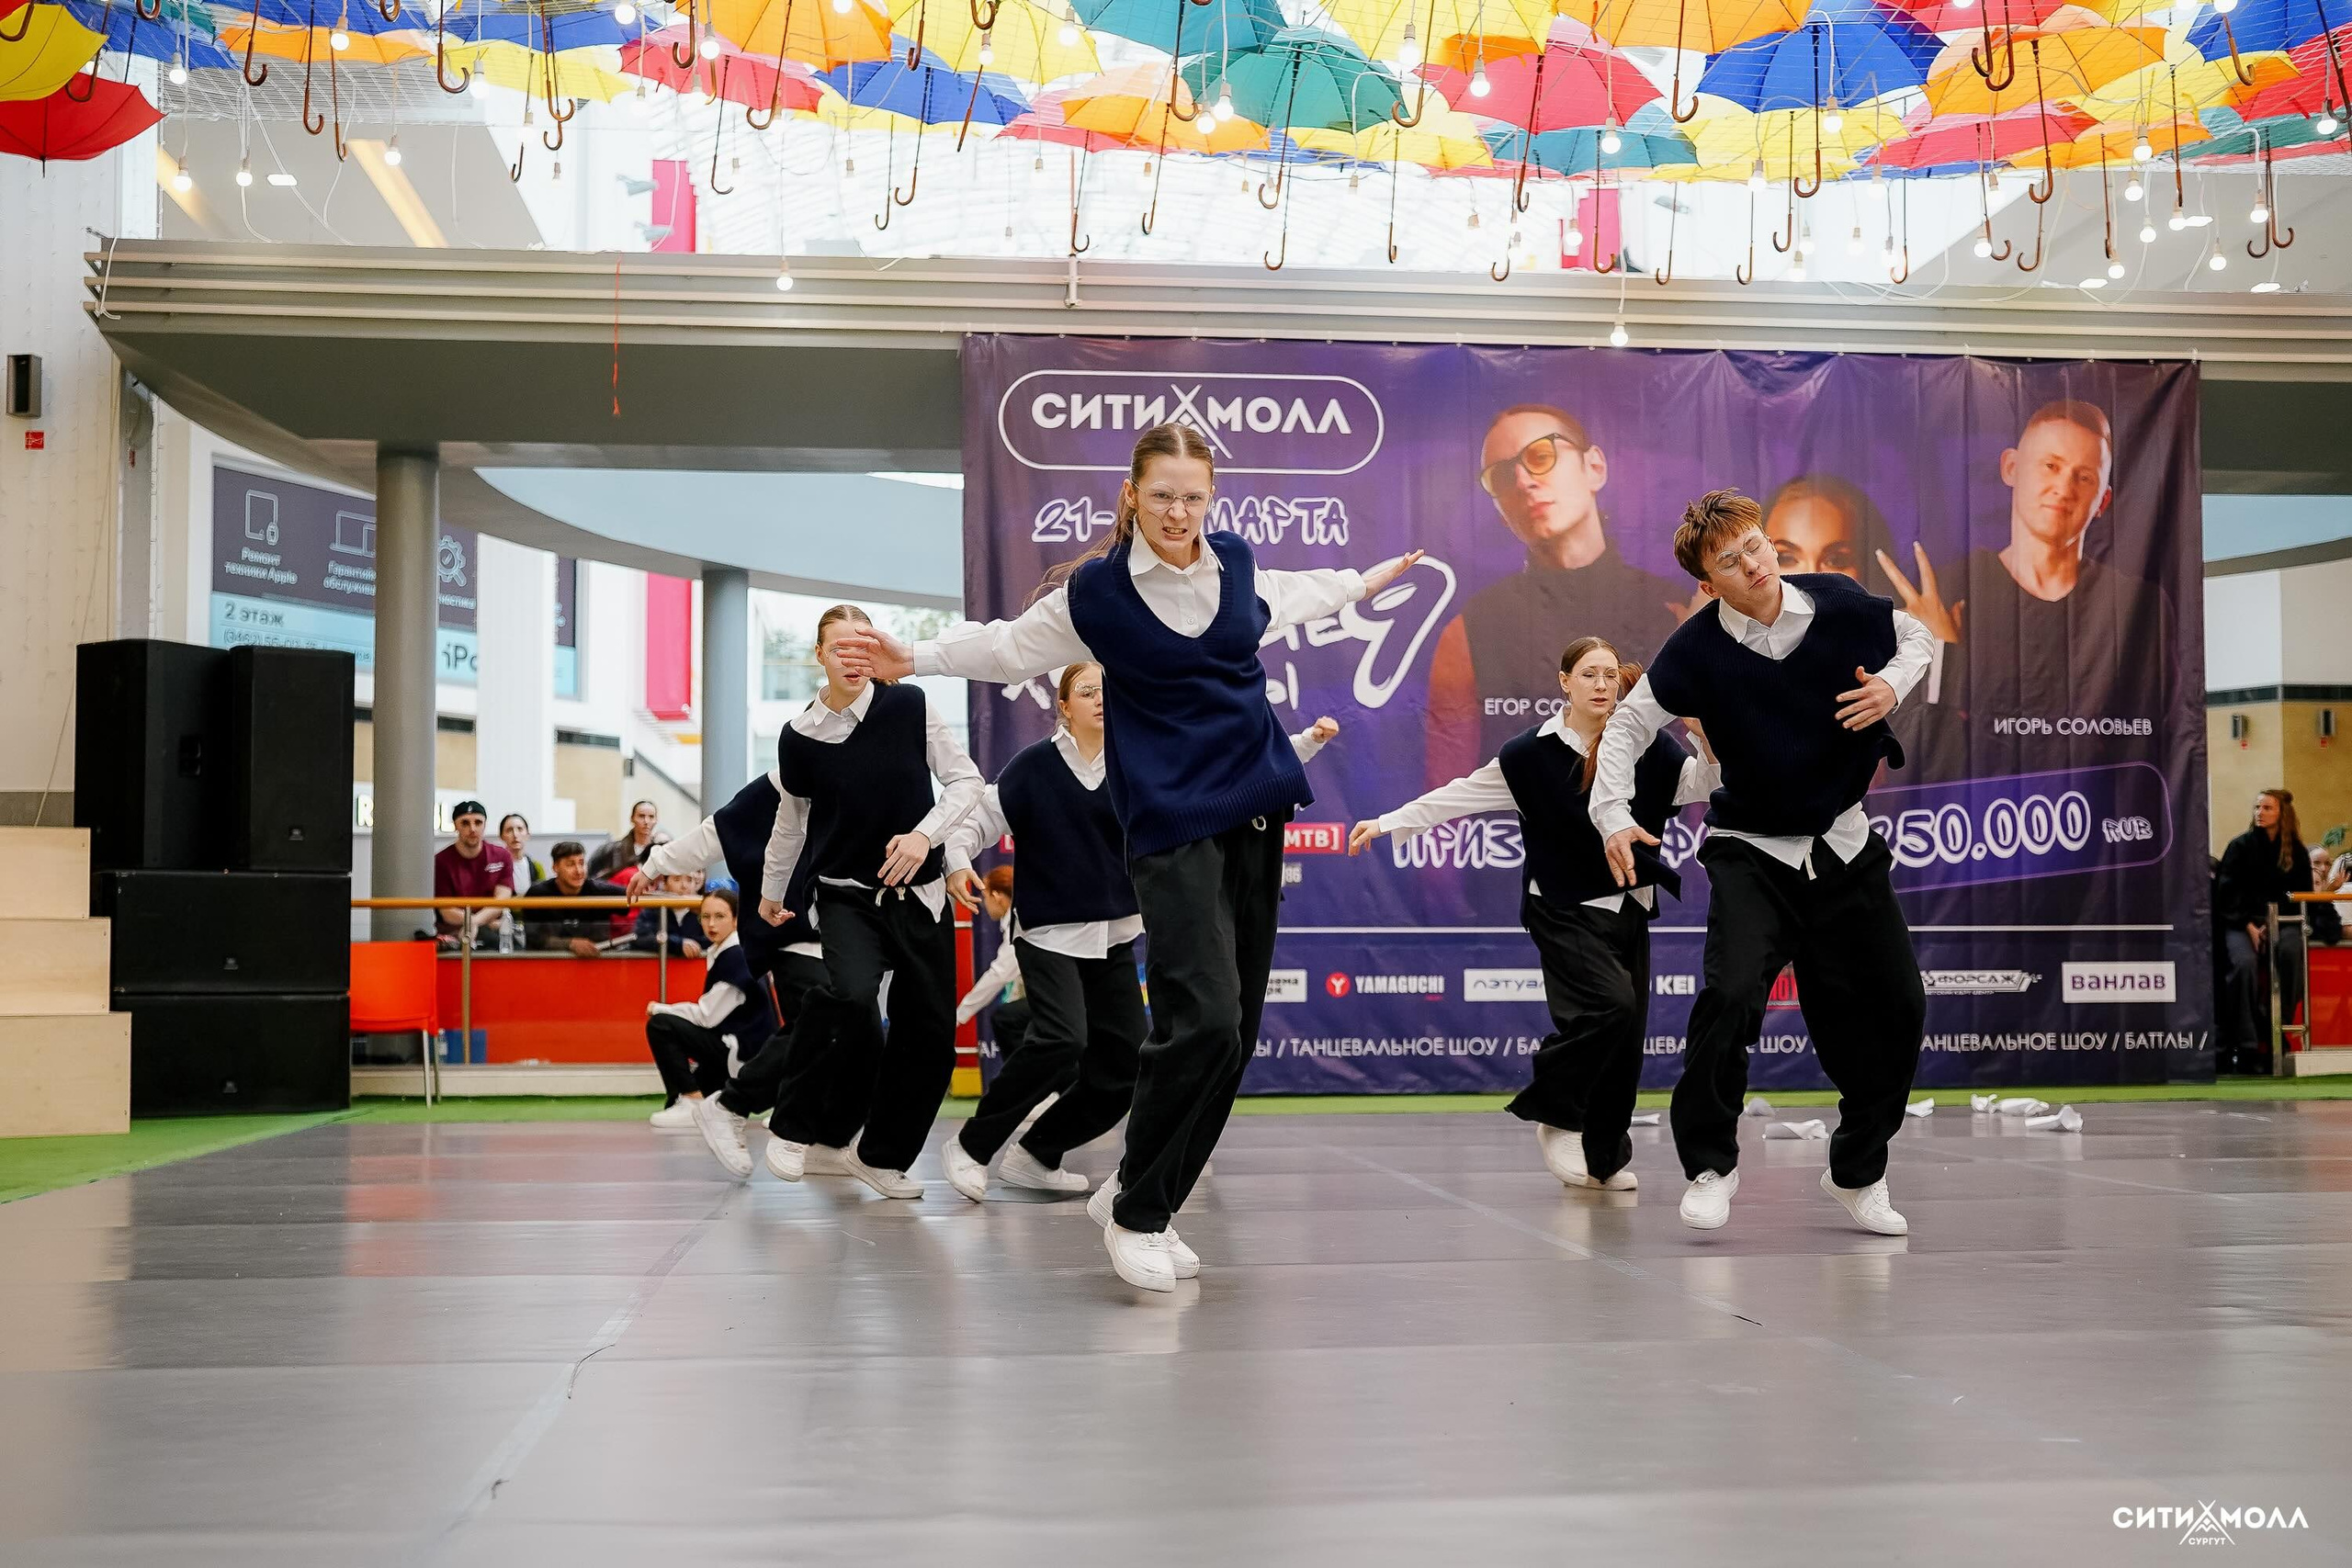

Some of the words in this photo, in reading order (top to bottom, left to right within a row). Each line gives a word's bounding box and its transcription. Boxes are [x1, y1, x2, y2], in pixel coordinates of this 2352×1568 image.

[1031, 495, 1115, 543] 21-
[241, 547, 281, 566] Ремонт
[267, 567, 299, 585] Apple
[327, 560, 377, 581] Гарантий
[323, 576, 377, 596] обслужива
[225, 602, 235, 620] 2
[241, 609, 285, 628] этаж
[1485, 698, 1532, 716] ЕГОР
[1994, 717, 2052, 735] ИГОРЬ
[2056, 717, 2153, 736] СОЛОВЬЕВ
[1390, 818, 1526, 869] ПРИЗ
[2102, 817, 2154, 843] RUB
[1355, 976, 1445, 995] YAMAGUCHI
[2071, 974, 2166, 991] ванлав
[1290, 1037, 1444, 1057] ТАНЦЕВАЛЬНОЕ
[1449, 1037, 1499, 1056] ШОУ
[1758, 1035, 1809, 1055] ШОУ
[1920, 1032, 2056, 1054] АНЦЕВАЛЬНОЕ
[2061, 1032, 2108, 1051] ШОУ
[2125, 1031, 2193, 1050] БАТТЛЫ
